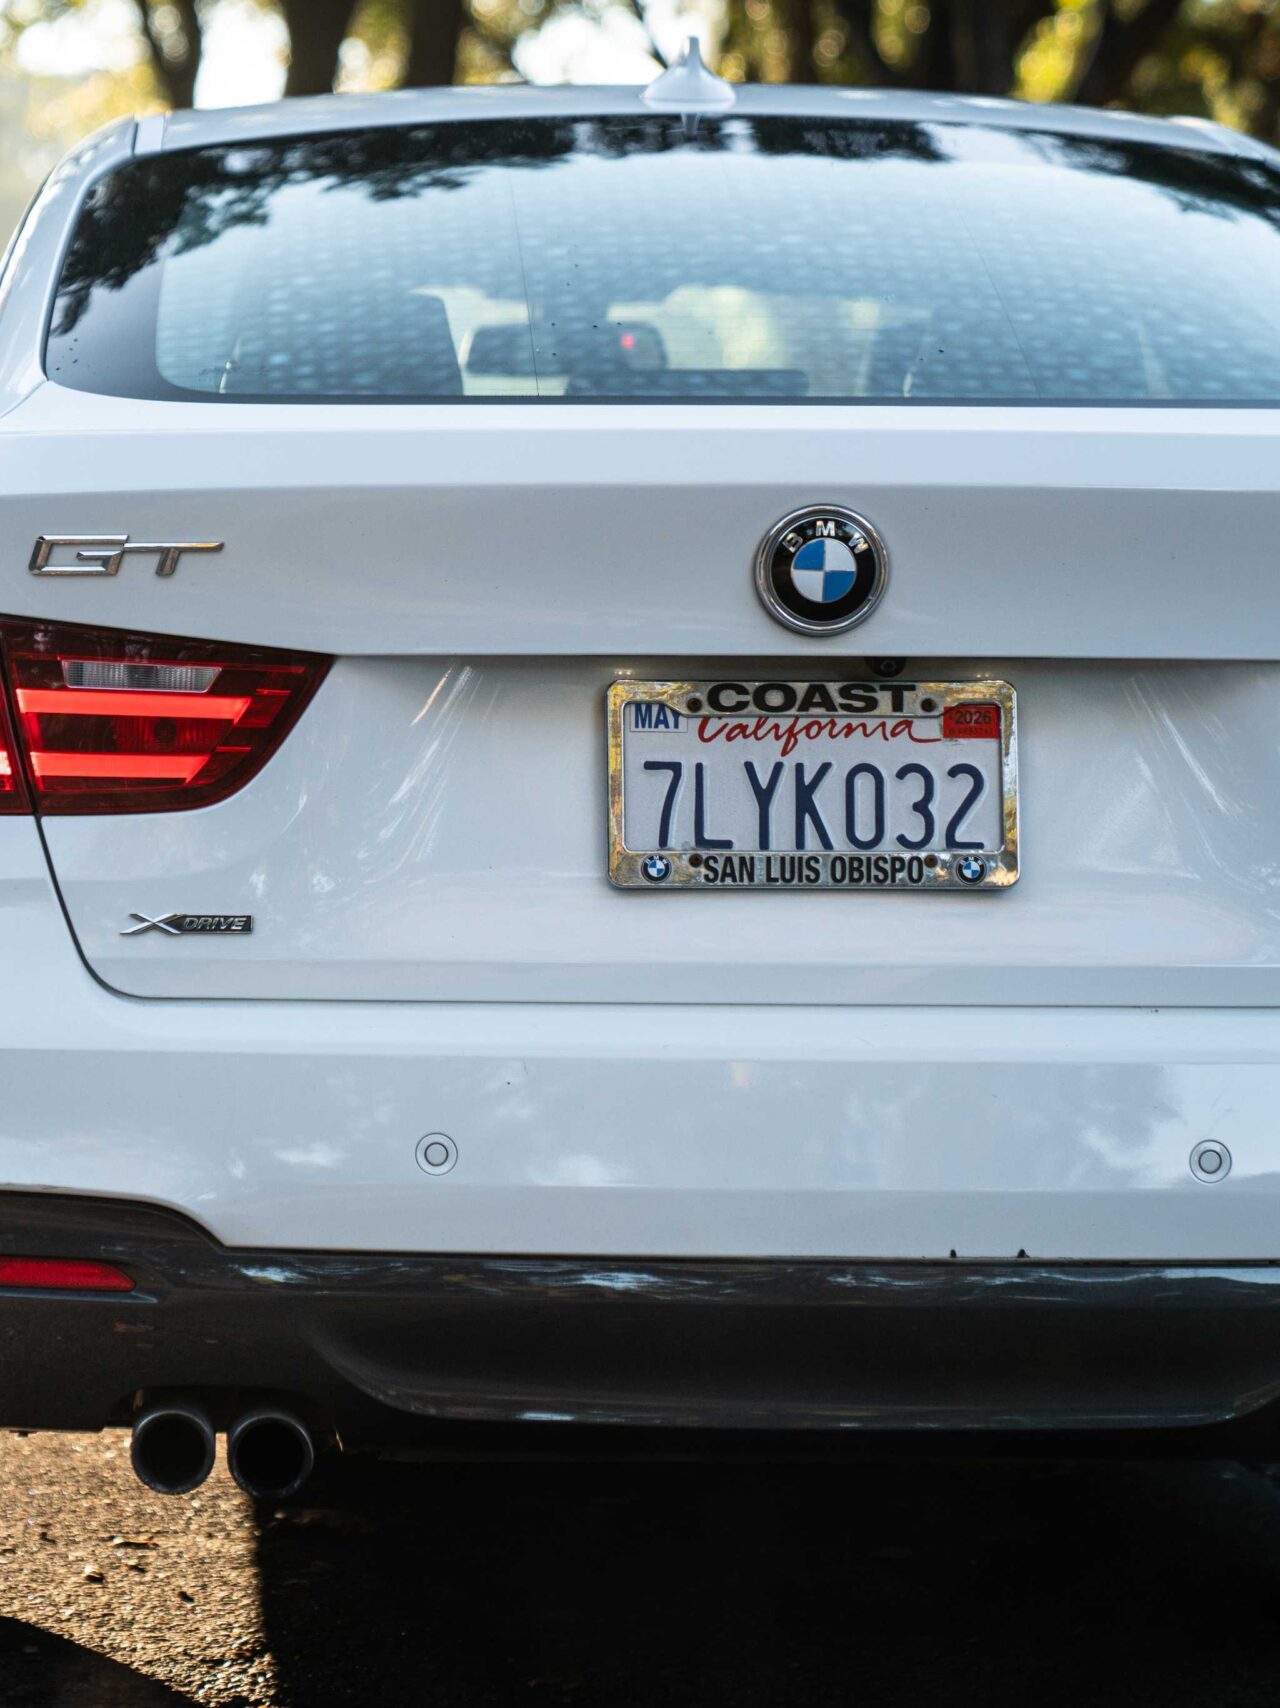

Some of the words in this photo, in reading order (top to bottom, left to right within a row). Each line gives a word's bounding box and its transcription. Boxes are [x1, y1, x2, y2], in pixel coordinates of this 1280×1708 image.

[781, 520, 870, 555] BMW
[28, 534, 225, 577] GT
[706, 682, 917, 714] COAST
[634, 702, 682, 729] MAY
[955, 709, 992, 725] 2026
[697, 716, 942, 757] California
[643, 760, 986, 851] 7LYK032
[703, 855, 755, 884] SAN
[766, 855, 820, 884] LUIS
[830, 855, 924, 884] OBISPO
